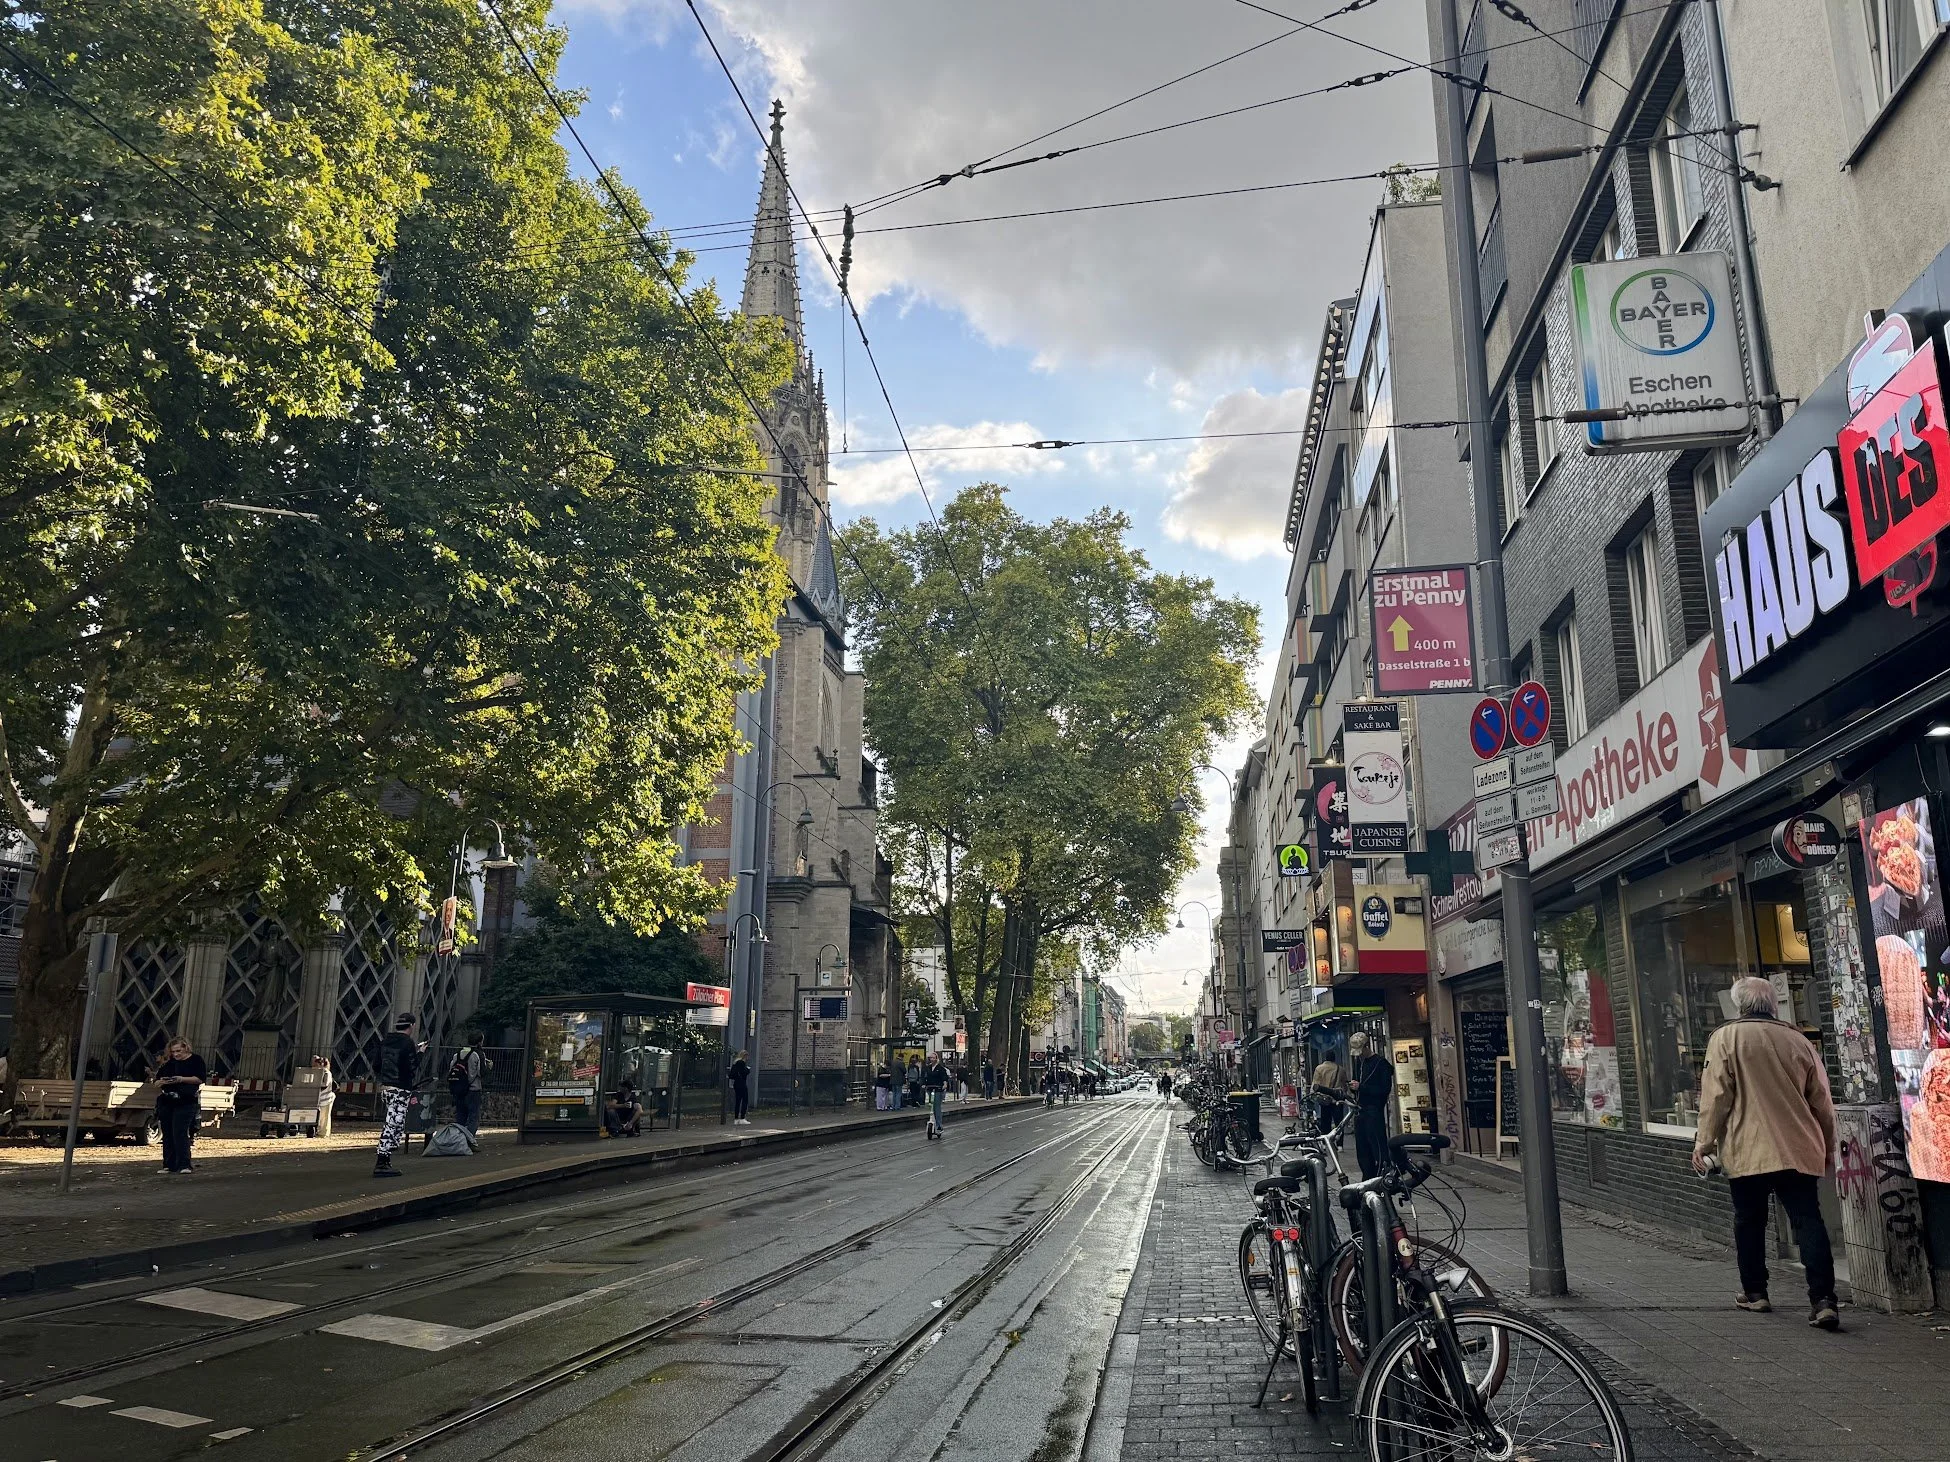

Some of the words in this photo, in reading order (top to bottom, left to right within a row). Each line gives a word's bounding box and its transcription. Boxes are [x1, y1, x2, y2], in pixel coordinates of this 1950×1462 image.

[1619, 301, 1707, 323] BAYER
[1651, 276, 1677, 348] BAYER
[1628, 373, 1713, 395] Eschen
[1715, 449, 1850, 682] HAUS
[1854, 392, 1939, 547] DES
[1373, 571, 1451, 592] Erstmal
[1374, 593, 1398, 608] zu
[1402, 589, 1466, 607] Penny
[1414, 639, 1440, 651] 400
[1443, 640, 1456, 649] m
[1378, 659, 1451, 671] Dasselstraße
[1453, 658, 1460, 667] 1
[1464, 657, 1471, 667] b
[1345, 704, 1396, 713] RESTAURANT
[1354, 722, 1374, 730] SAKE
[1533, 750, 1543, 761] dem
[1476, 769, 1508, 788] Ladezone
[1484, 809, 1493, 818] auf
[1493, 805, 1504, 816] dem
[1354, 827, 1405, 837] JAPANESE
[1803, 823, 1826, 833] HAUS
[1359, 838, 1402, 847] CUISINE
[1807, 844, 1837, 855] DÖNERS
[1363, 911, 1389, 922] Gaffel
[1264, 931, 1282, 940] VENUS
[1283, 931, 1303, 940] CELLER
